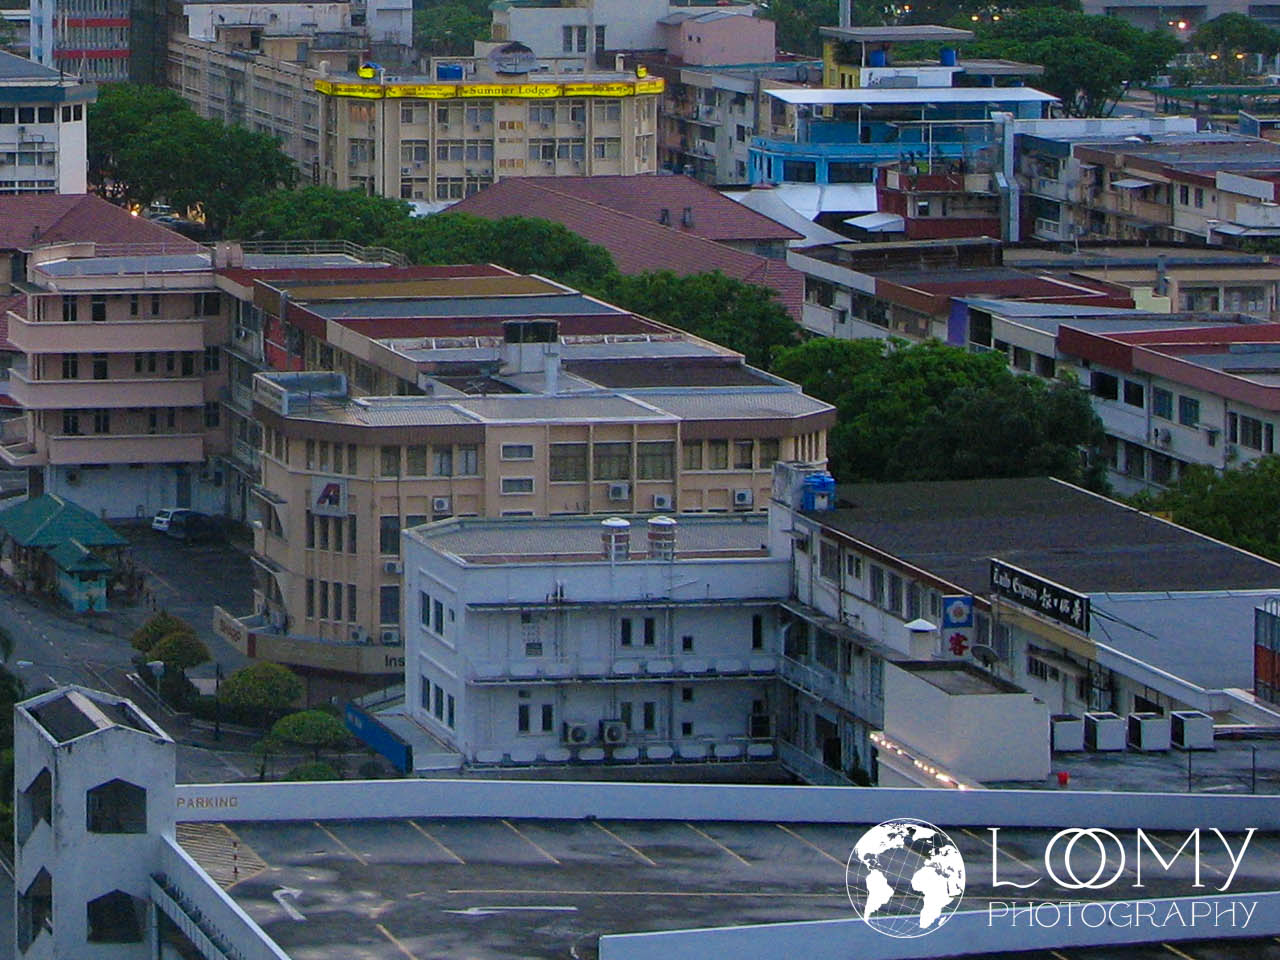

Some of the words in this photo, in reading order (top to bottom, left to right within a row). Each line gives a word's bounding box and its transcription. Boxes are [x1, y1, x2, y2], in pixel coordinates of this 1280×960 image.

[470, 86, 514, 96] Summer
[519, 85, 551, 97] Lodge
[176, 796, 239, 809] PARKING
